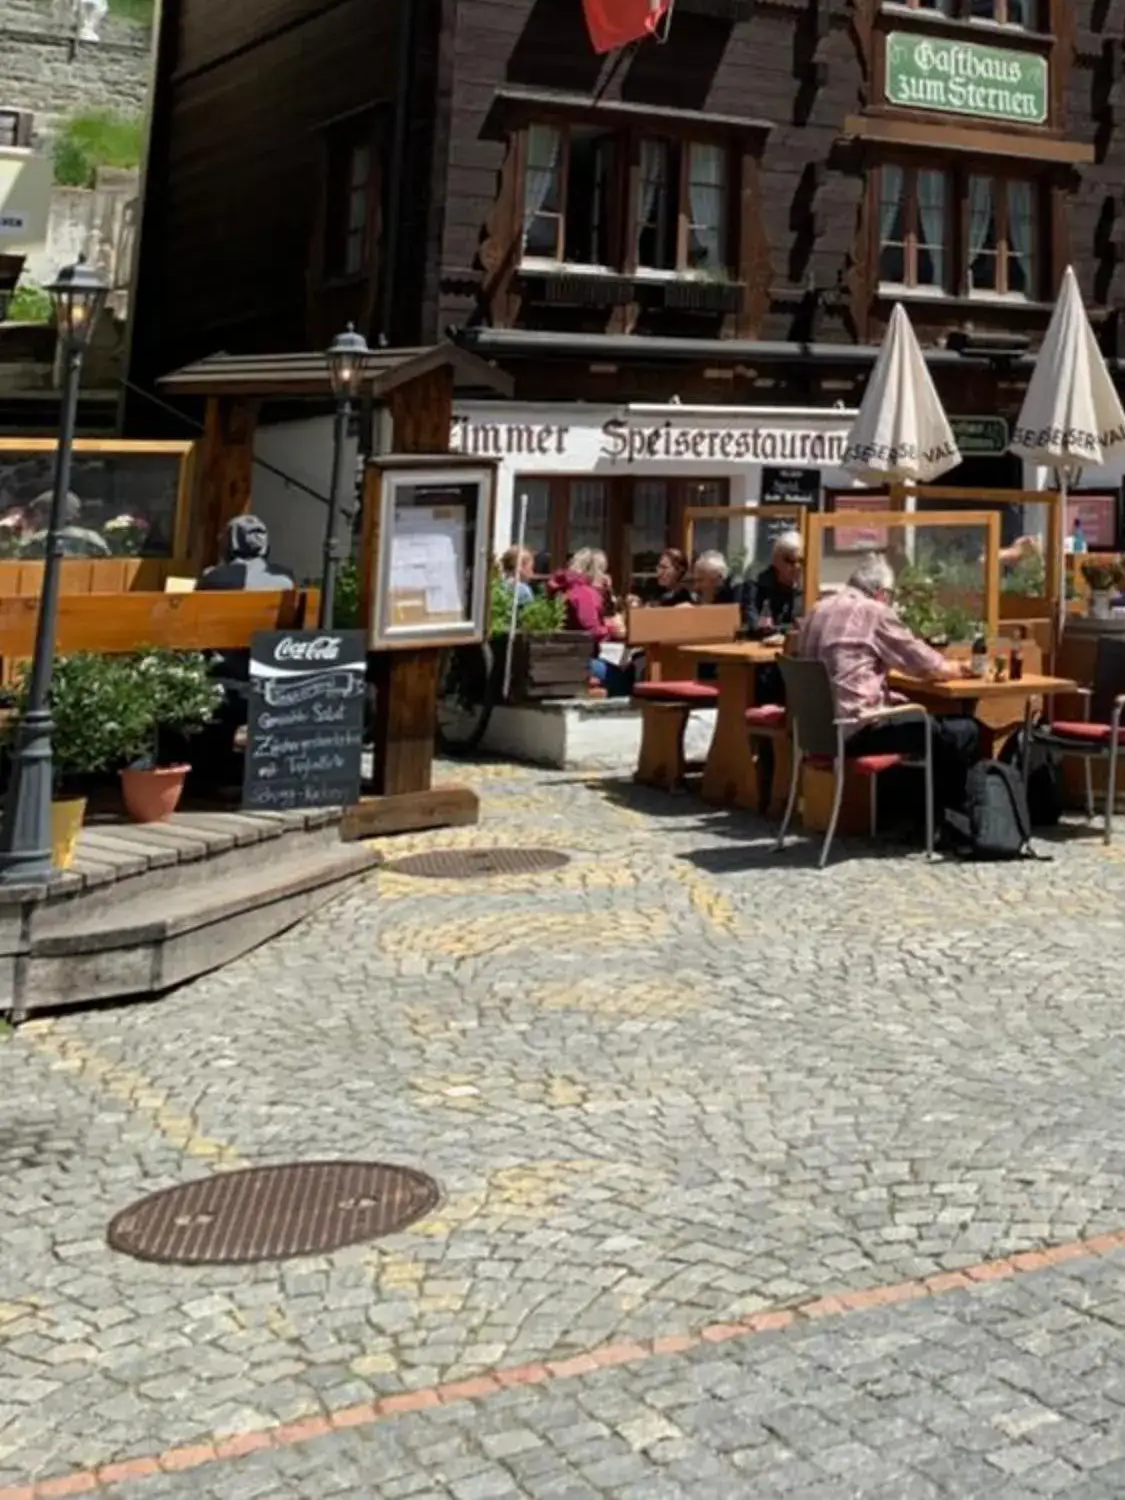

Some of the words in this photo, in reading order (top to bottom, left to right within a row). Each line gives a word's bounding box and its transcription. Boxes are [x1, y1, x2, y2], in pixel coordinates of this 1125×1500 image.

[897, 73, 946, 104] zum
[947, 78, 1038, 117] Sternen
[450, 414, 569, 455] immer
[602, 417, 843, 464] Speiserestauran
